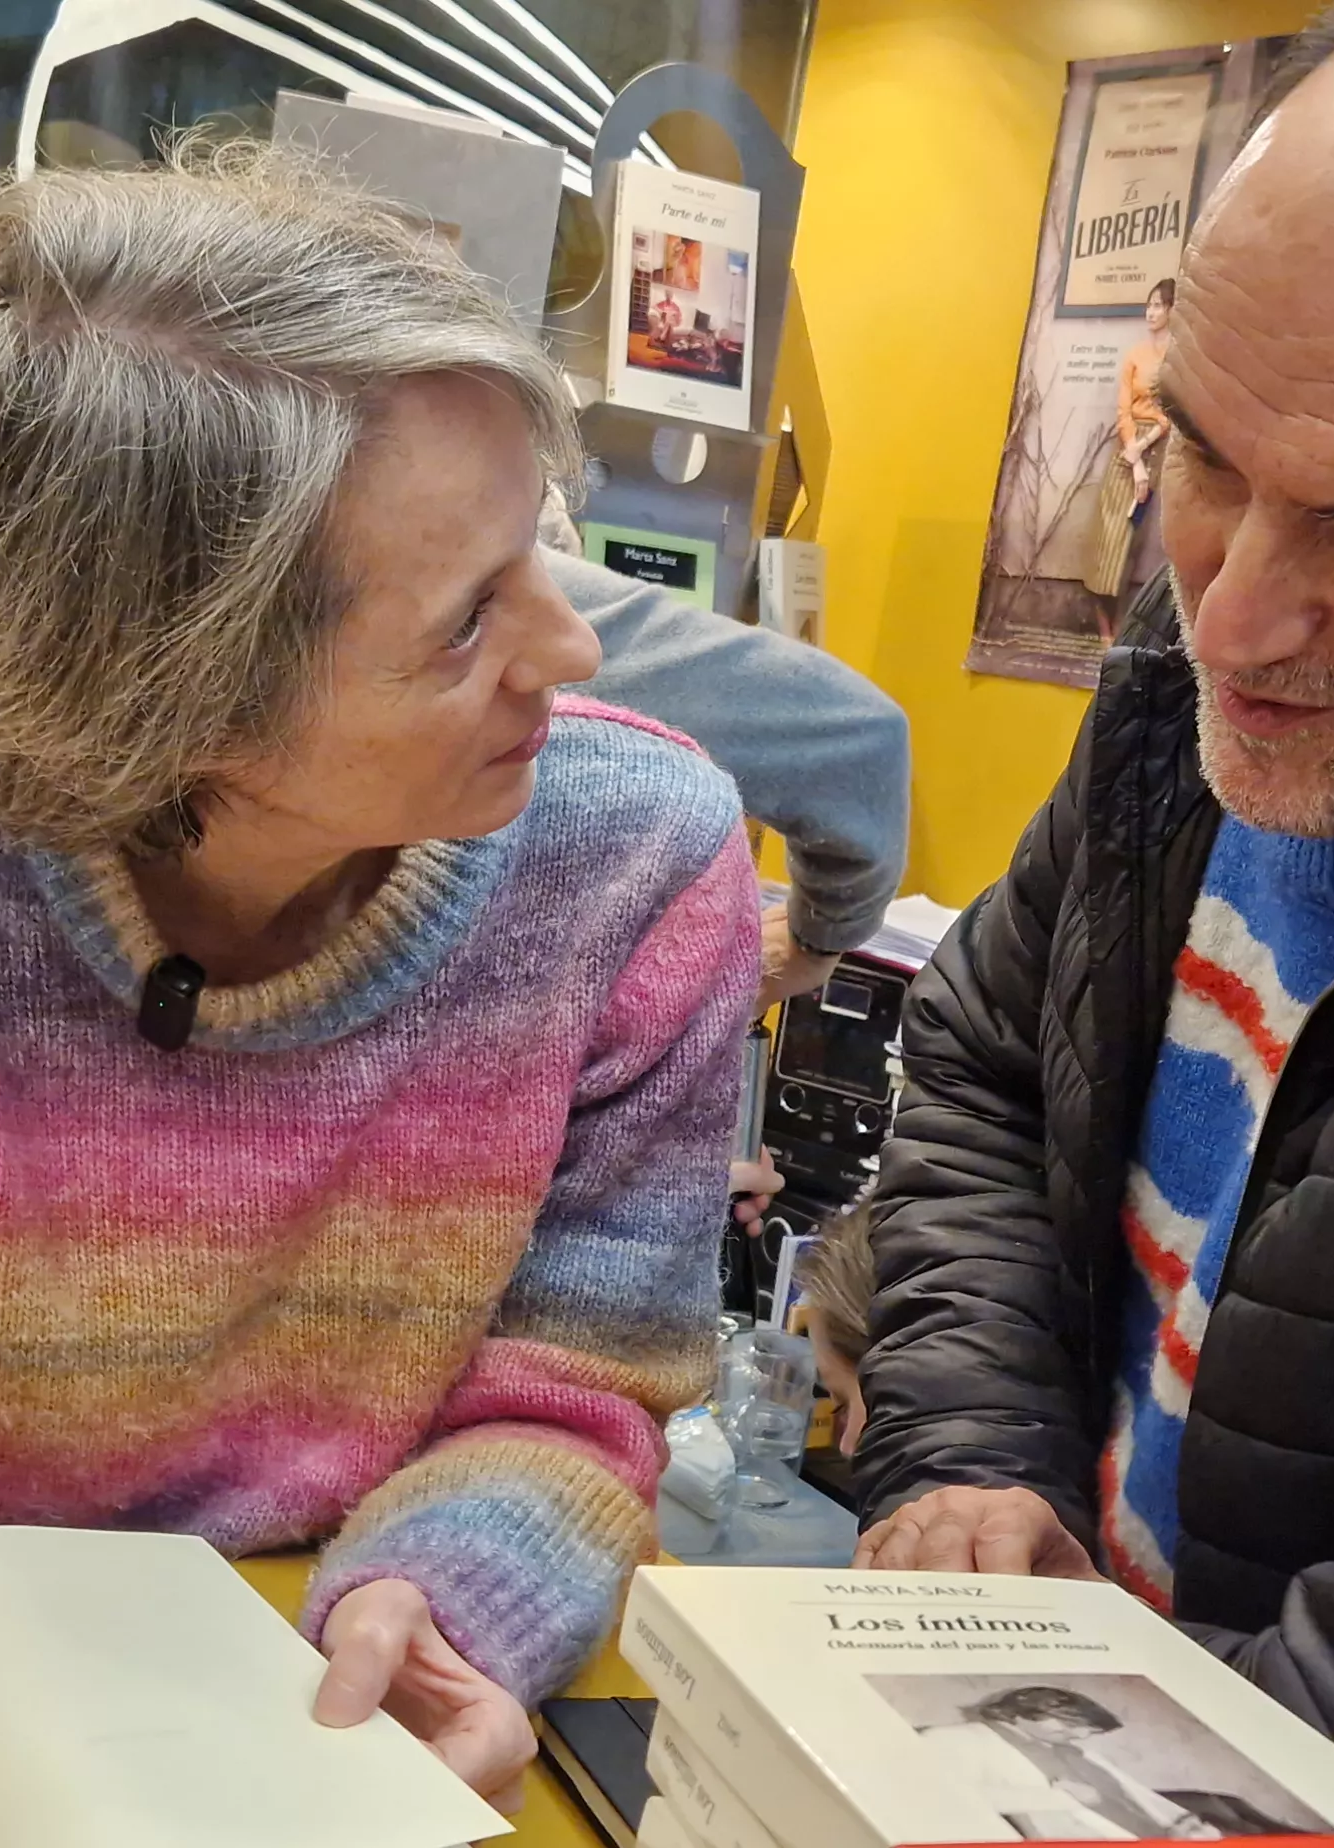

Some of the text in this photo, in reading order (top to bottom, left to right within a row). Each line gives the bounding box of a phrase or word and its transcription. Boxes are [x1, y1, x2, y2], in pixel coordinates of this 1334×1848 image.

[661, 203, 692, 220] Parte
[694, 212, 708, 223] de
[1075, 191, 1181, 260] LIBRERÍA
[624, 547, 678, 567] Marta Sanz
[824, 1584, 992, 1598] MARTA SANZ
[825, 1612, 1072, 1634] Los íntimos
[827, 1638, 1111, 1654] (Memoria del pan y las rosas)
